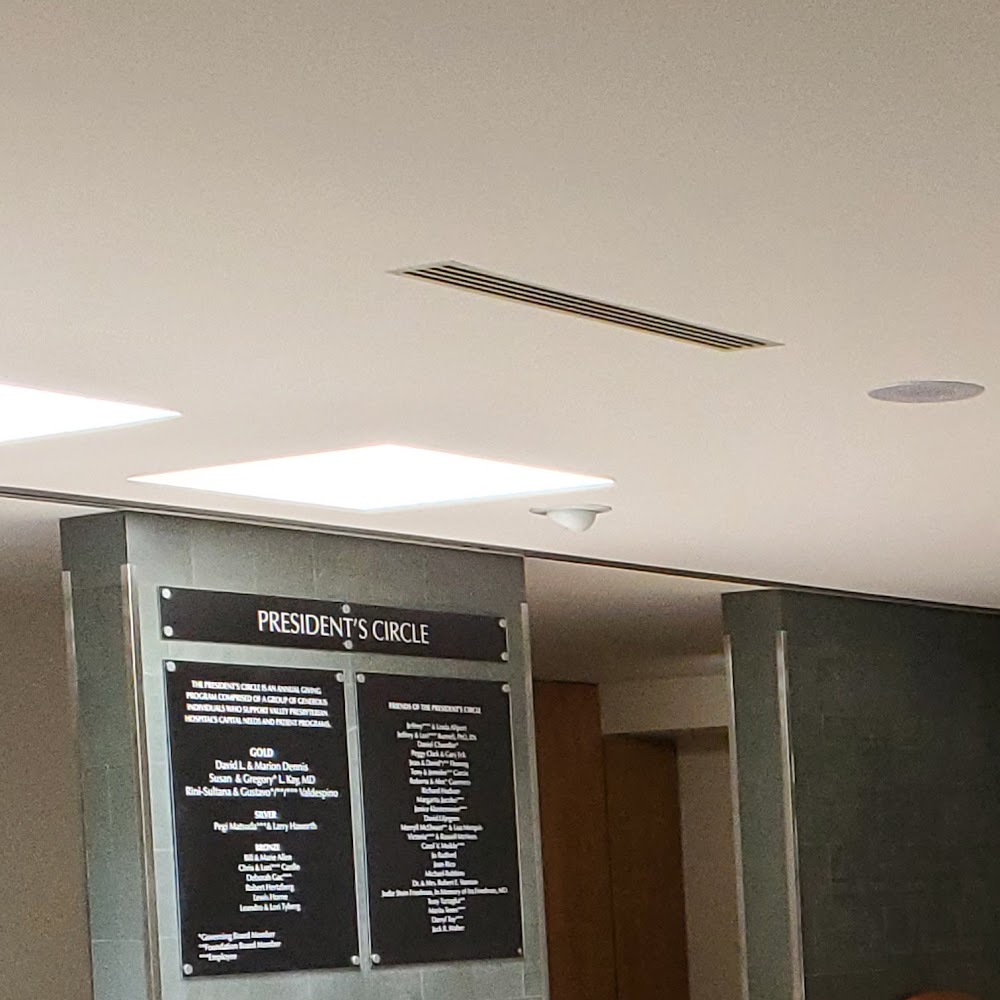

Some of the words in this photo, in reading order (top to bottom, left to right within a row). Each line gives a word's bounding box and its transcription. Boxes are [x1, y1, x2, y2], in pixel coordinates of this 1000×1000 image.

[257, 610, 368, 640] PRESIDENT'S
[372, 620, 429, 644] CIRCLE
[192, 680, 203, 688] THE
[204, 681, 240, 690] PRESIDENT'S
[241, 683, 260, 691] CIRCLE
[301, 686, 321, 694] GIVING
[186, 692, 217, 701] PROGRAM
[218, 693, 252, 702] COMPRISED
[253, 695, 261, 703] OF
[268, 696, 288, 704] GROUP
[187, 704, 225, 712] INDIVIDUALS
[225, 705, 242, 713] WHO
[243, 706, 268, 714] SUPPORT
[219, 716, 242, 725] CAPITAL
[243, 717, 261, 725] NEEDS
[262, 718, 275, 726] AND
[249, 747, 274, 758] GOLD
[215, 760, 238, 770] David
[247, 761, 253, 770] &
[255, 761, 281, 771] Marion
[282, 761, 309, 771] Dennis
[209, 773, 232, 784] Susan
[235, 774, 242, 784] &
[302, 775, 316, 785] MD
[233, 787, 238, 797] &
[254, 811, 278, 819] SILVER
